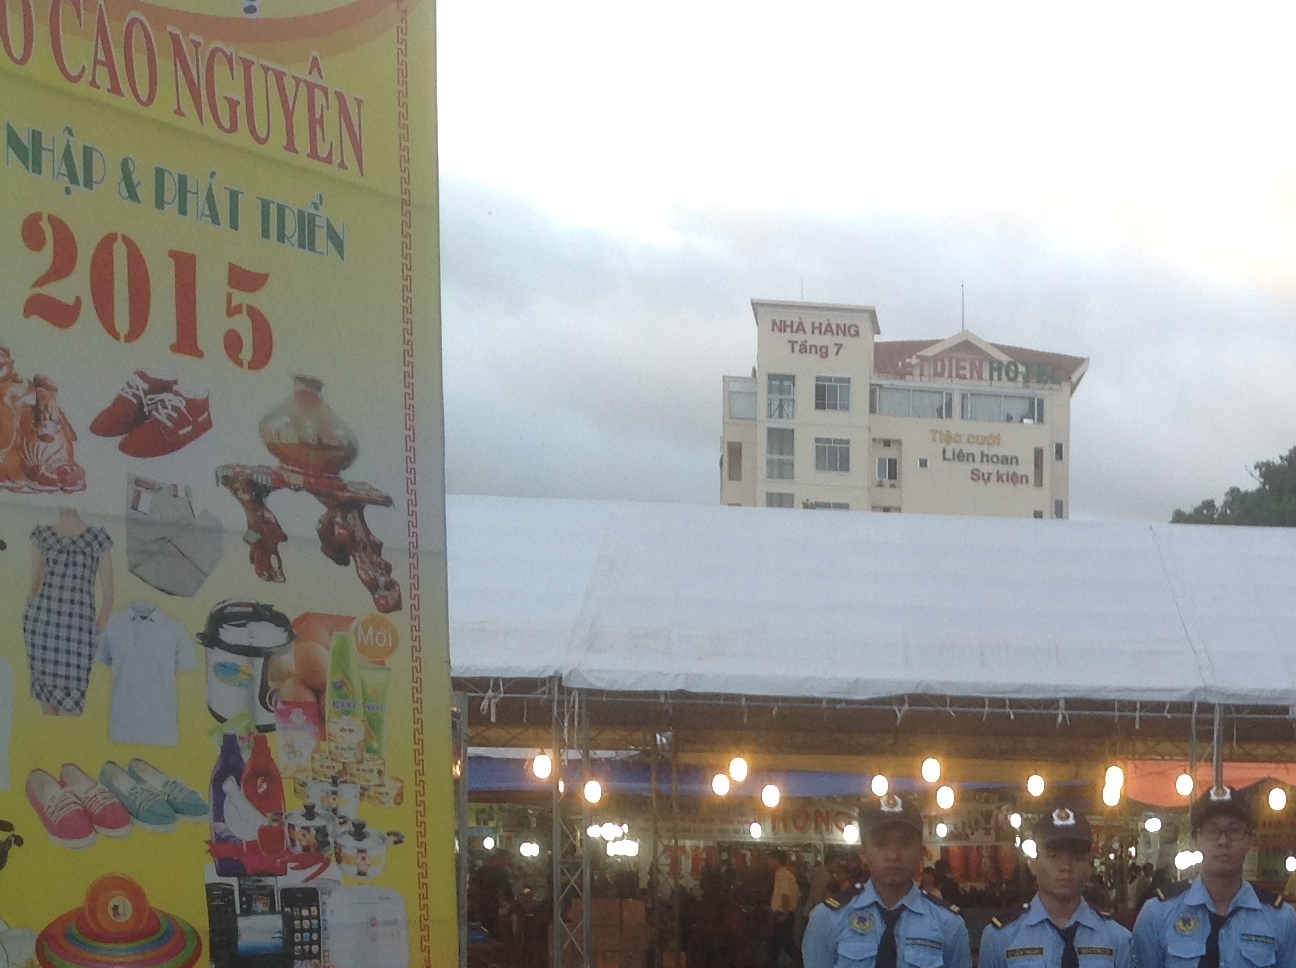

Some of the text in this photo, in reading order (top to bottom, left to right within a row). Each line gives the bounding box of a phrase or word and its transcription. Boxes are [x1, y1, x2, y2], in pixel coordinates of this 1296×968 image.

[49, 0, 158, 107] CAO
[168, 30, 365, 177] NGUYÊN
[6, 121, 345, 261] NHẬP & PHÁT TRIỂN
[21, 211, 274, 371] 2015
[771, 317, 860, 337] NHÀ HÀNG
[834, 343, 843, 356] 7
[942, 448, 1019, 466] Liên hoan
[970, 468, 1029, 486] Sự kiện
